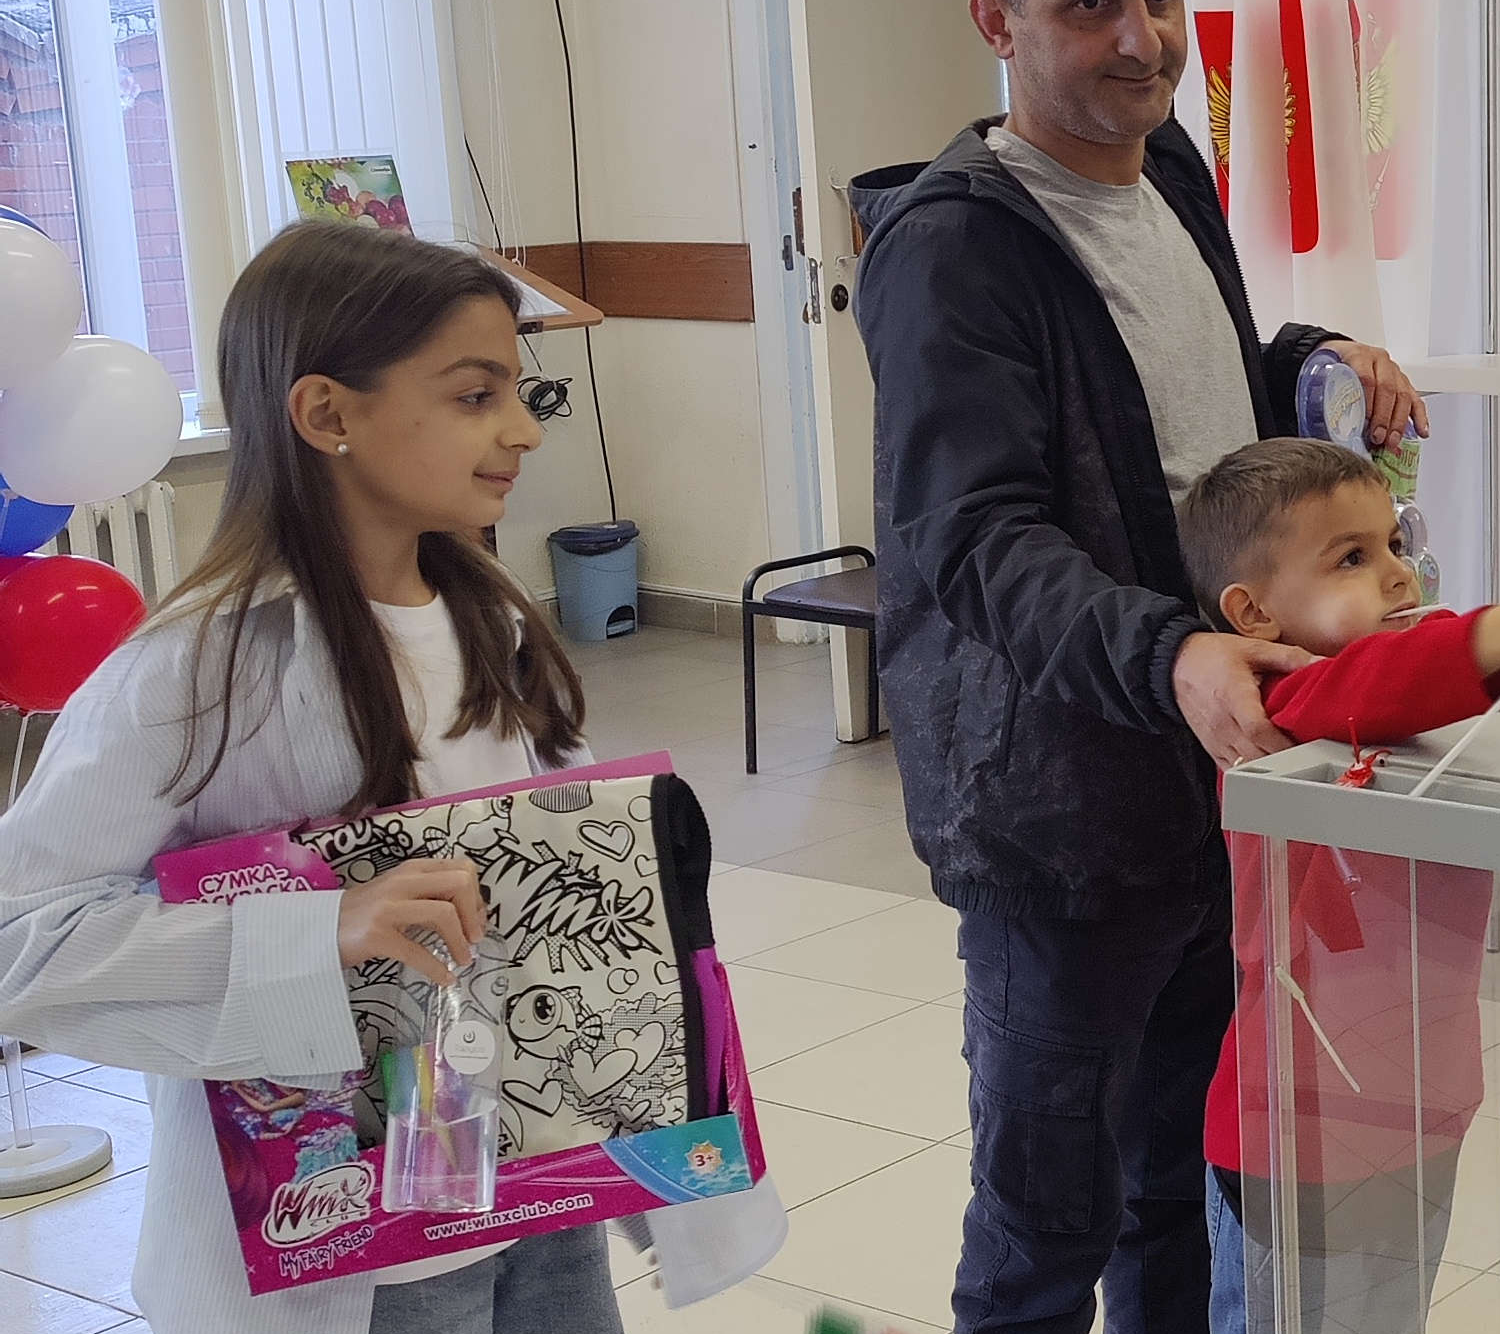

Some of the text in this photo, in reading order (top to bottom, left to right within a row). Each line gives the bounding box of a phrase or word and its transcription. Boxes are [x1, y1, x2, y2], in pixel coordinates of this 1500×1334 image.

[200, 865, 284, 895] СУМКА-
[695, 1154, 714, 1167] 3+
[425, 1194, 592, 1239] www.winxclub.com
